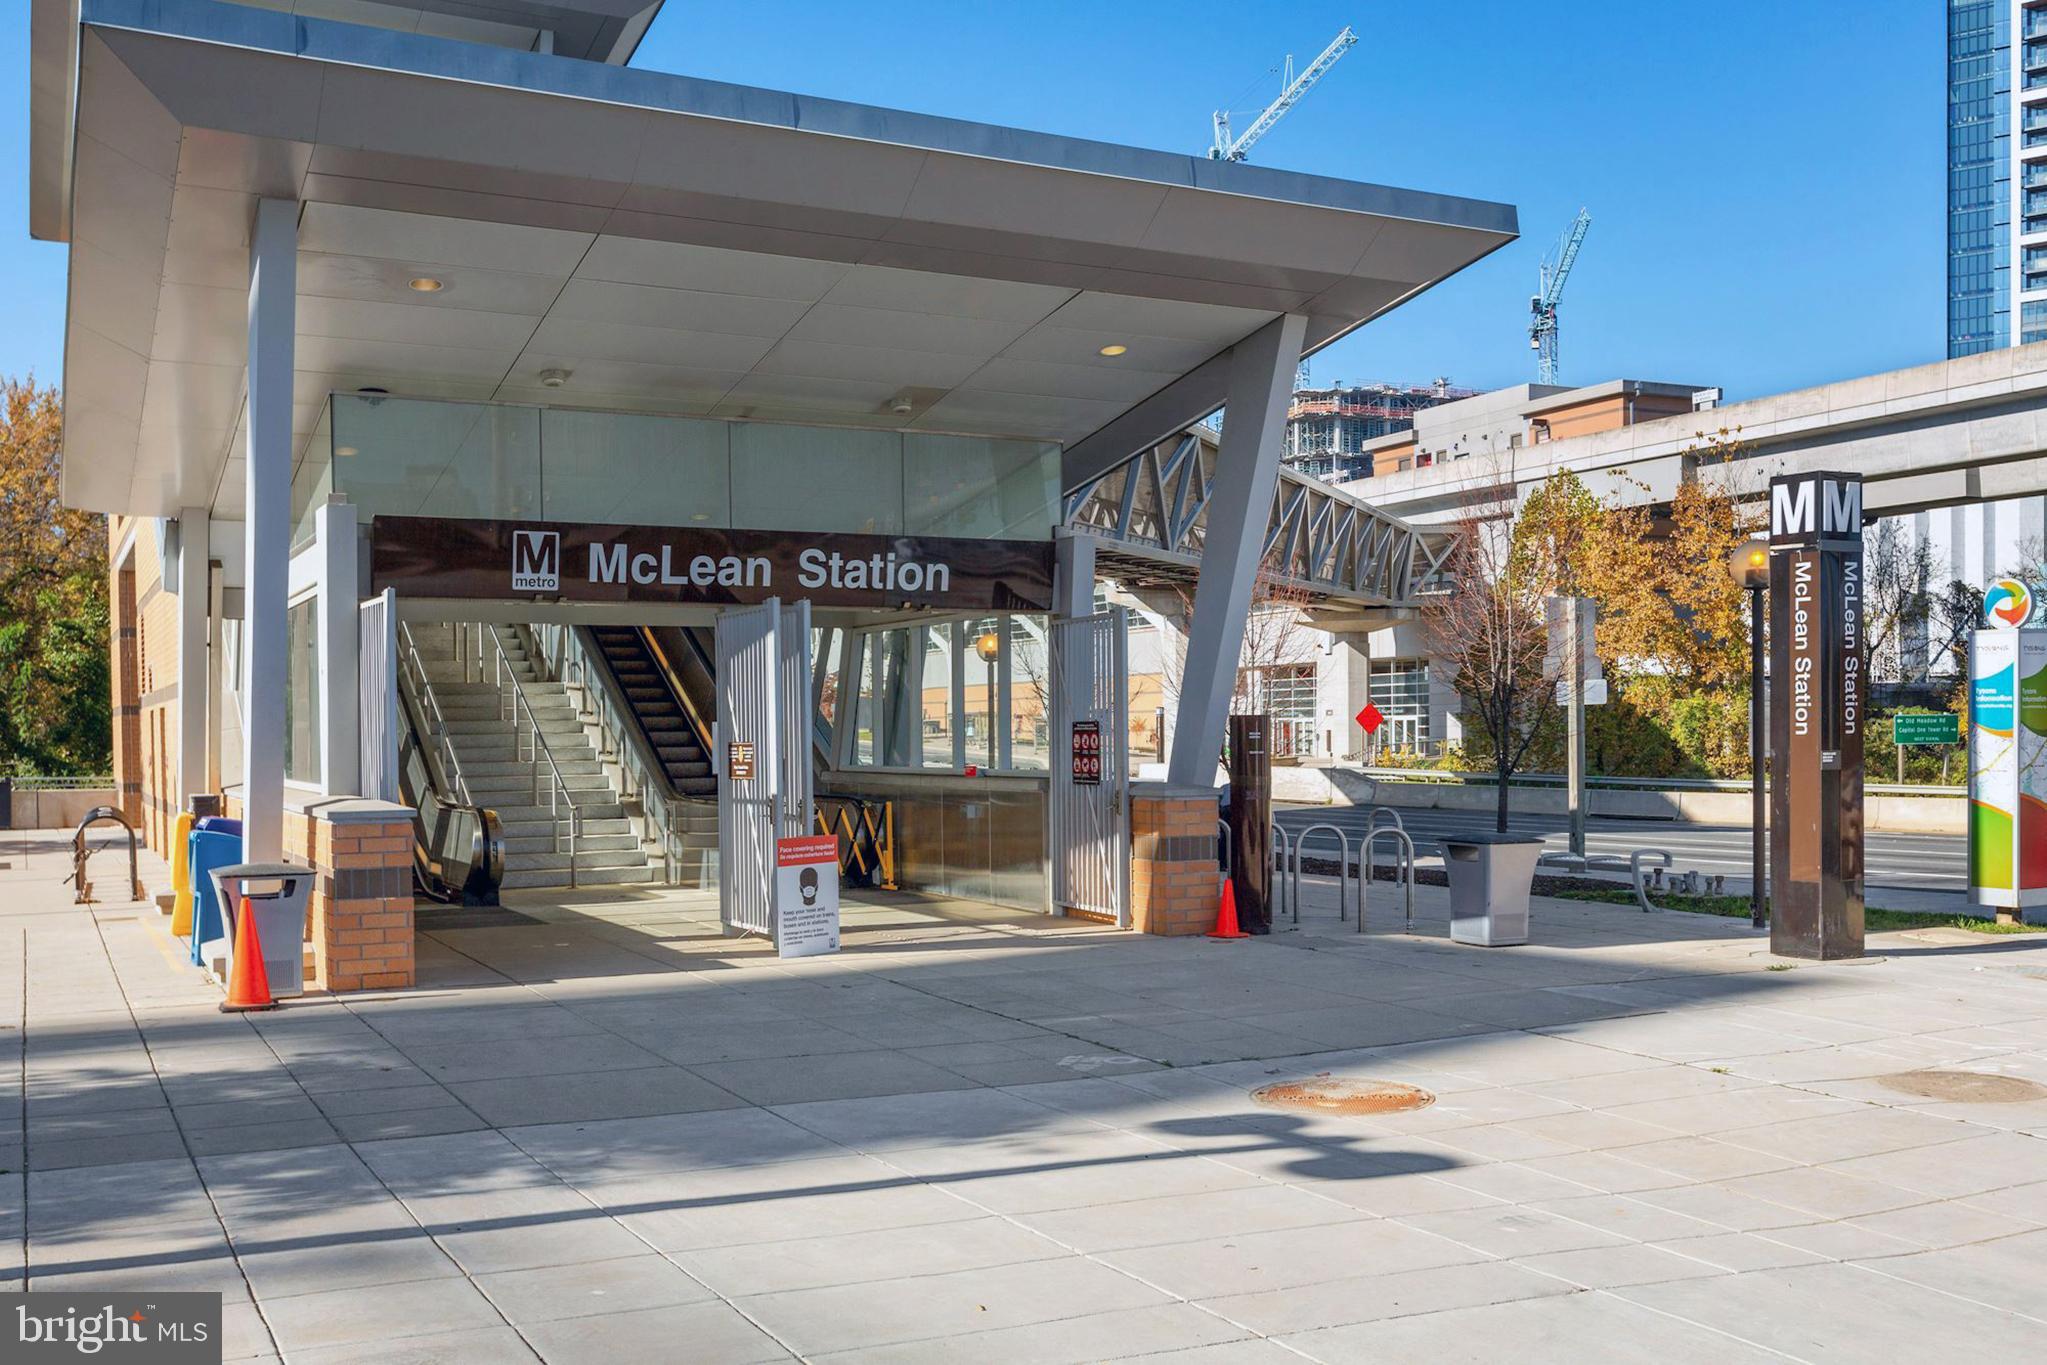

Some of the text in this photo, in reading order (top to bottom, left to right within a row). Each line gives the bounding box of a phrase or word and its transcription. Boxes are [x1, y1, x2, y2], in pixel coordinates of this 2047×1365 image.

[1772, 480, 1815, 536] M
[1823, 480, 1860, 533] M
[516, 534, 556, 574] M
[588, 542, 949, 592] McLean Station
[515, 577, 556, 588] metro
[1795, 561, 1812, 736] McLean Station
[1844, 561, 1858, 735] McLean Station
